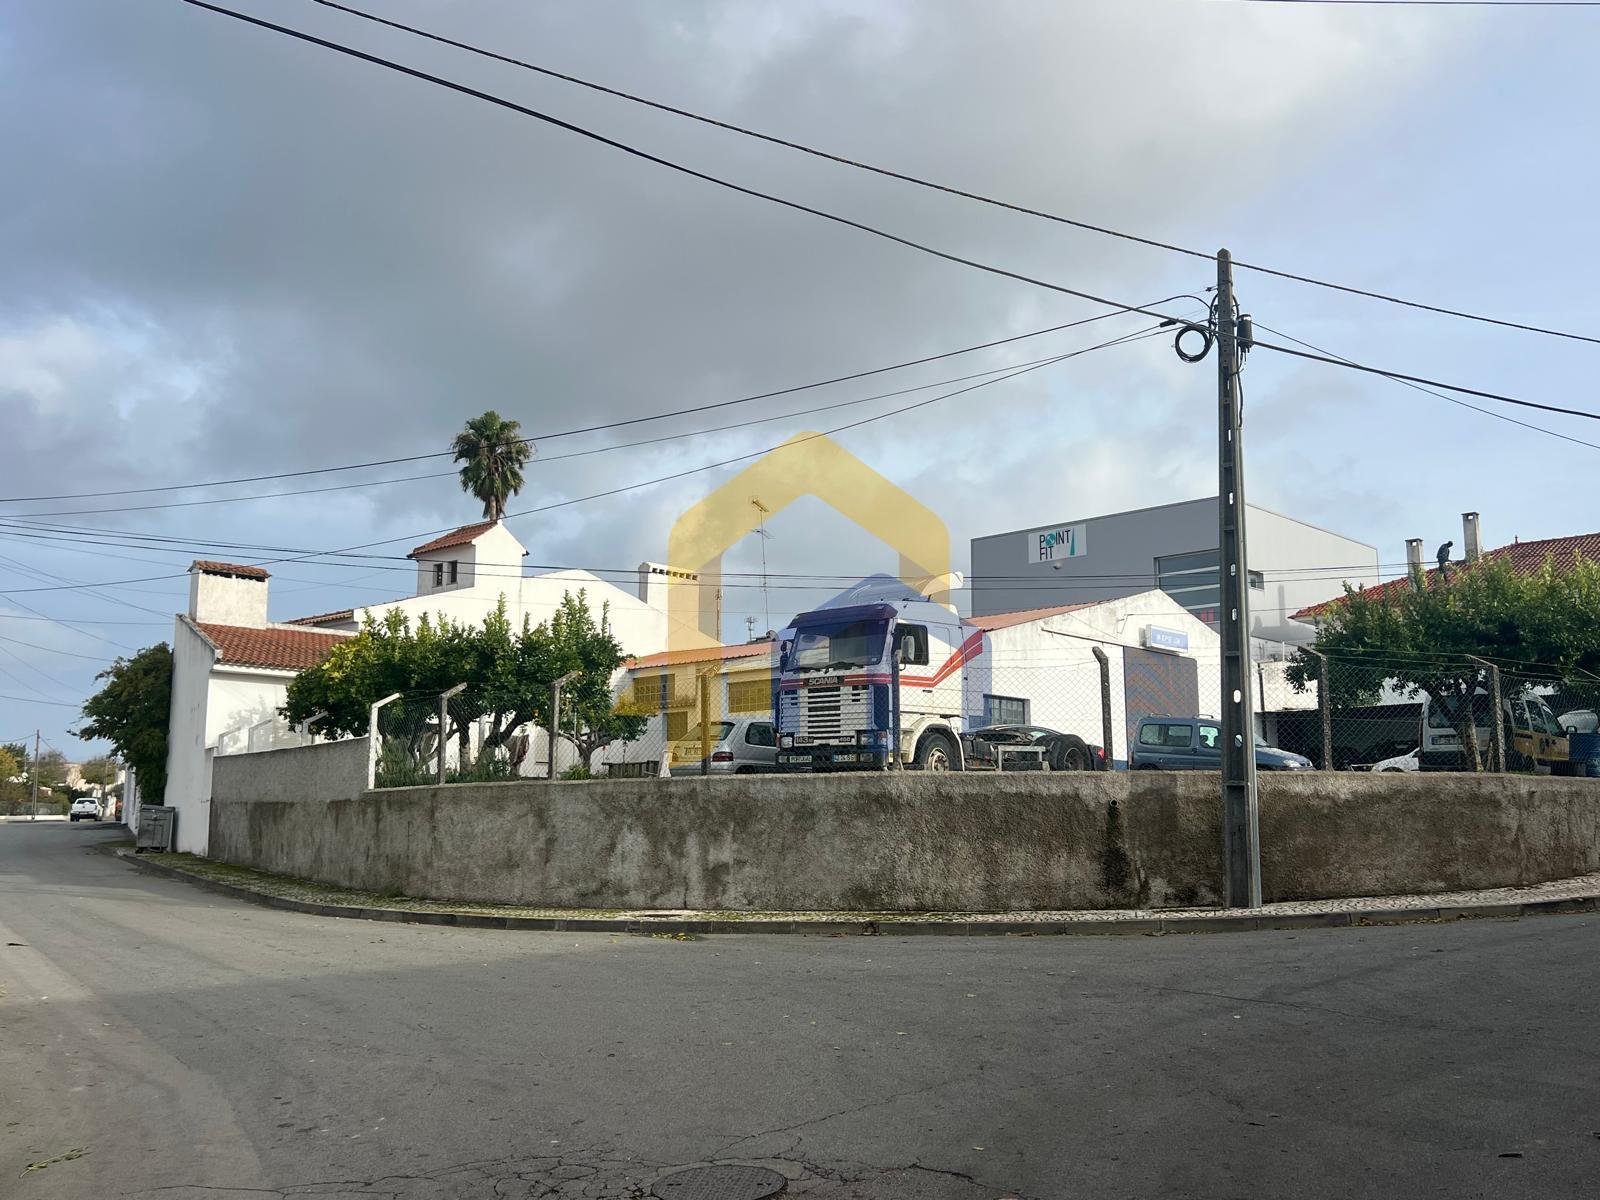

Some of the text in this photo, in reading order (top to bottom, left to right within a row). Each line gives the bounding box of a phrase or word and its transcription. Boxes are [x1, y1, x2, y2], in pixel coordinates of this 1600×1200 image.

[1039, 529, 1071, 546] POINT
[1039, 545, 1054, 561] FIT
[808, 676, 838, 685] SCANIA
